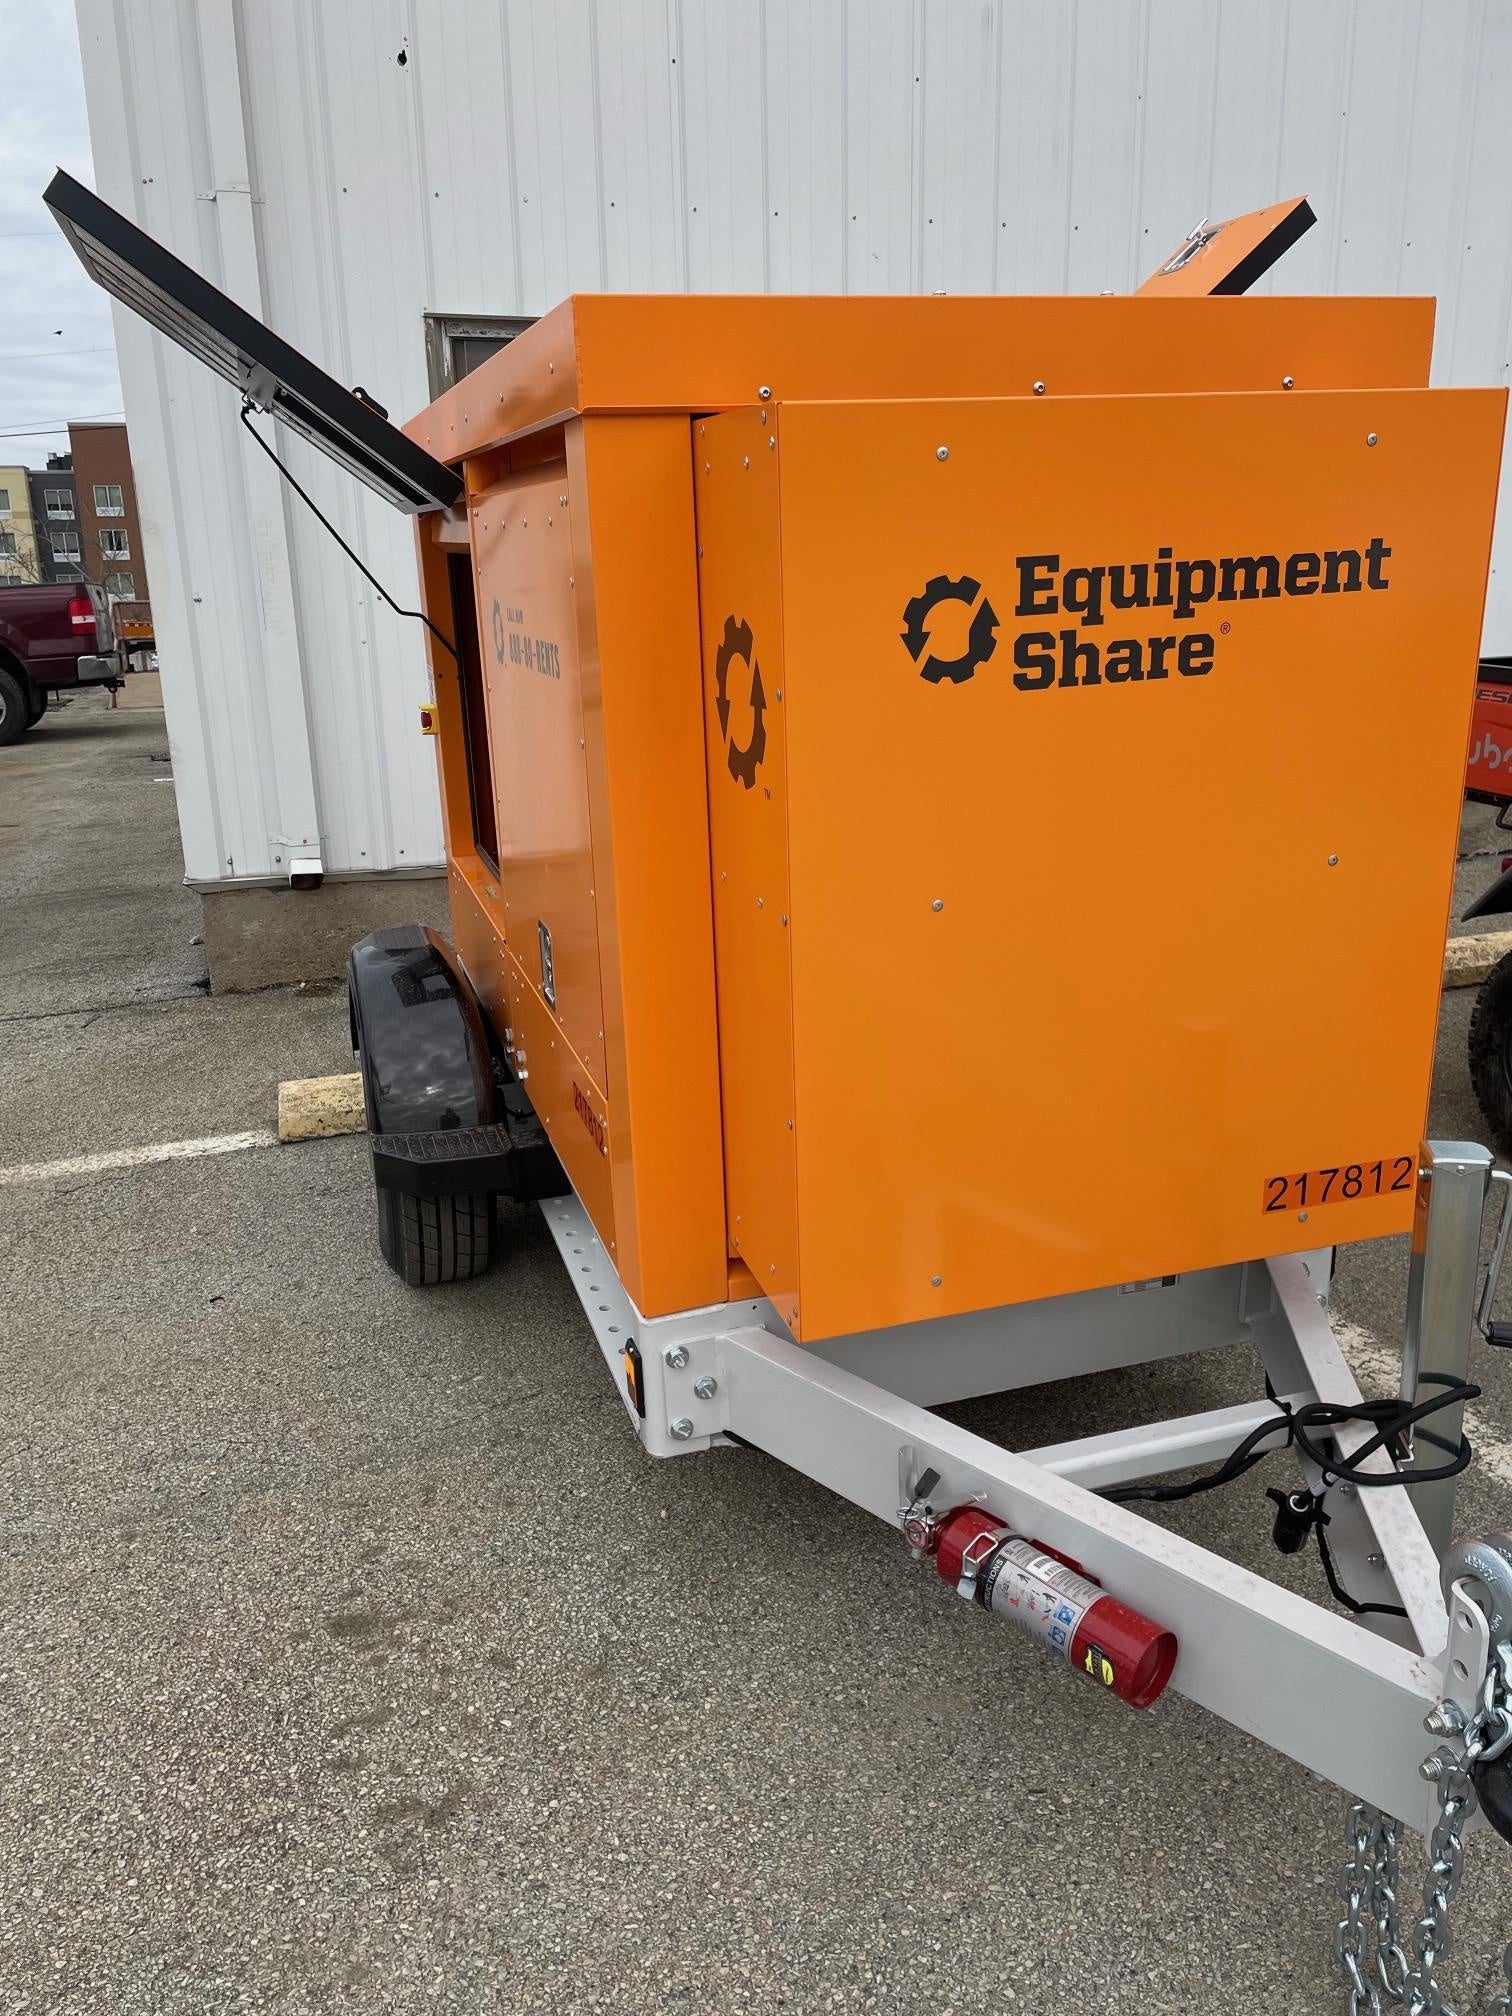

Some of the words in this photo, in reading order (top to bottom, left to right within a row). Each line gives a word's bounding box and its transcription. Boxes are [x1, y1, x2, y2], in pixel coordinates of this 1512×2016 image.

[1015, 538, 1392, 626] Equipment
[1013, 629, 1215, 691] Share
[1265, 1156, 1413, 1212] 217812
